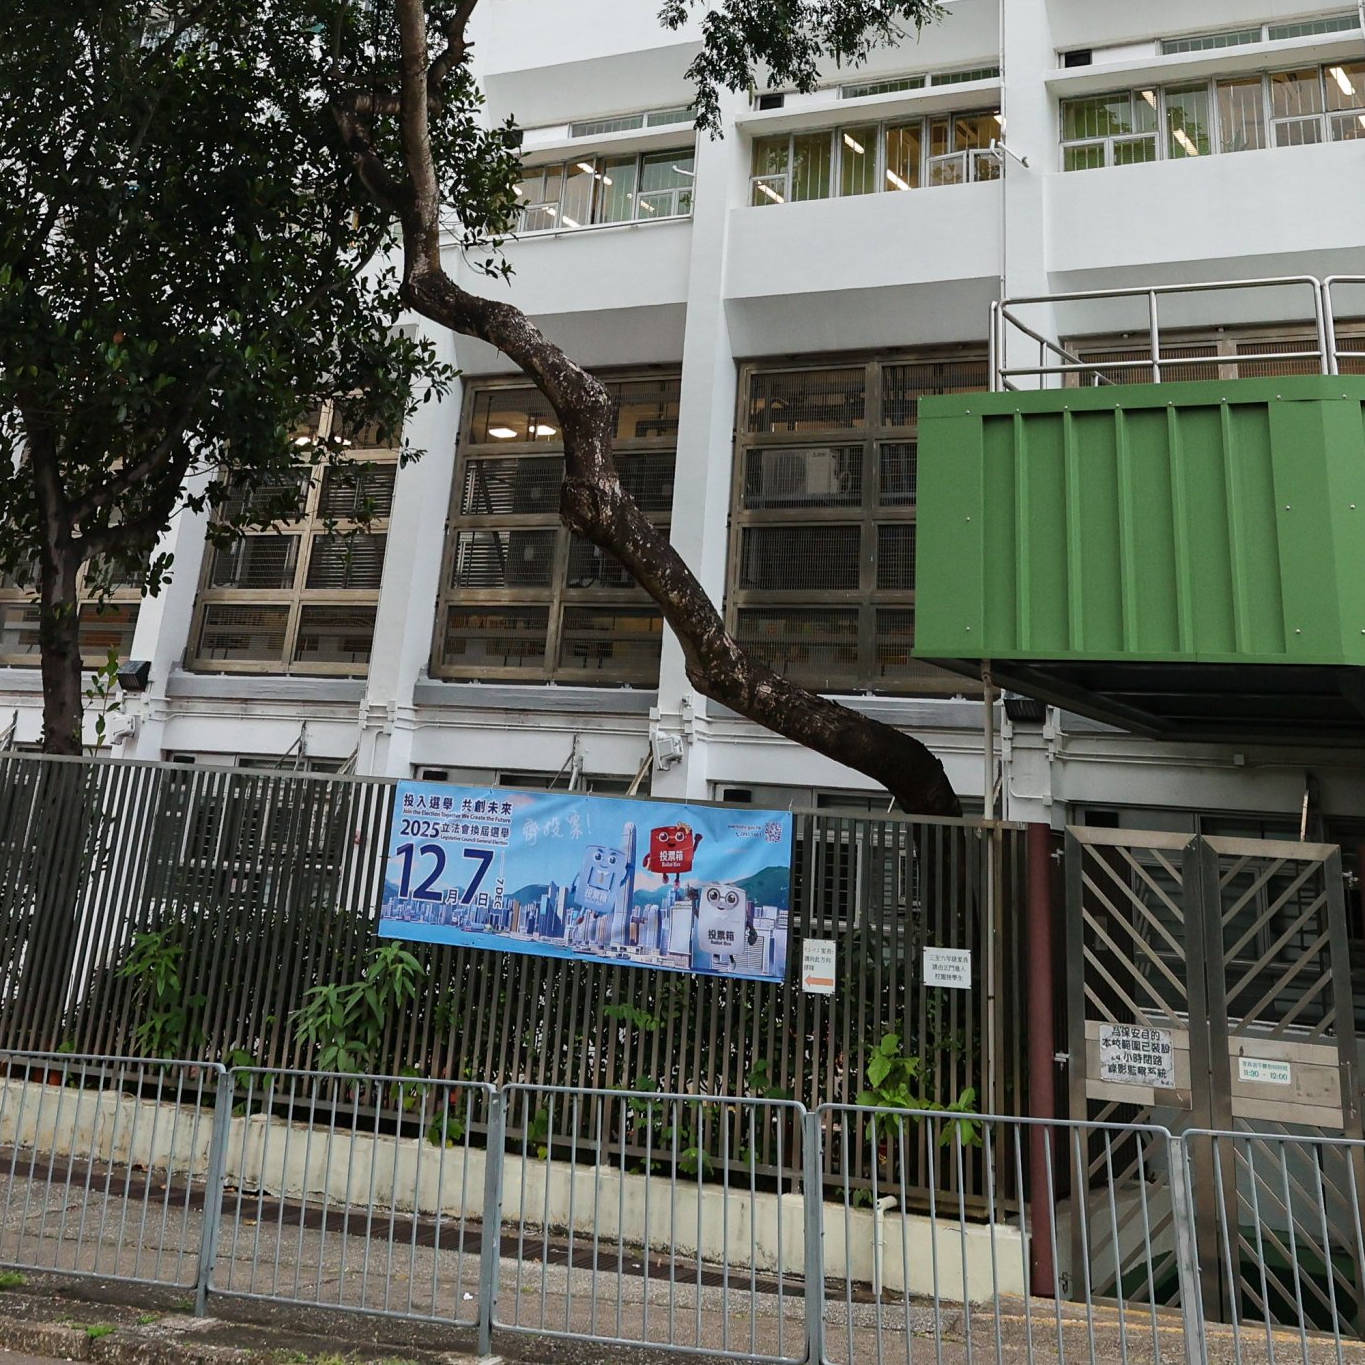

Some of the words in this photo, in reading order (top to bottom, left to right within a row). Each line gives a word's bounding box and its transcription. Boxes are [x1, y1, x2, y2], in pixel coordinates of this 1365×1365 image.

[403, 793, 453, 810] 投入選舉
[462, 799, 512, 815] 共創未來
[660, 850, 683, 861] 投票箱
[708, 929, 735, 941] 投票箱
[1270, 1072, 1288, 1080] 12:00
